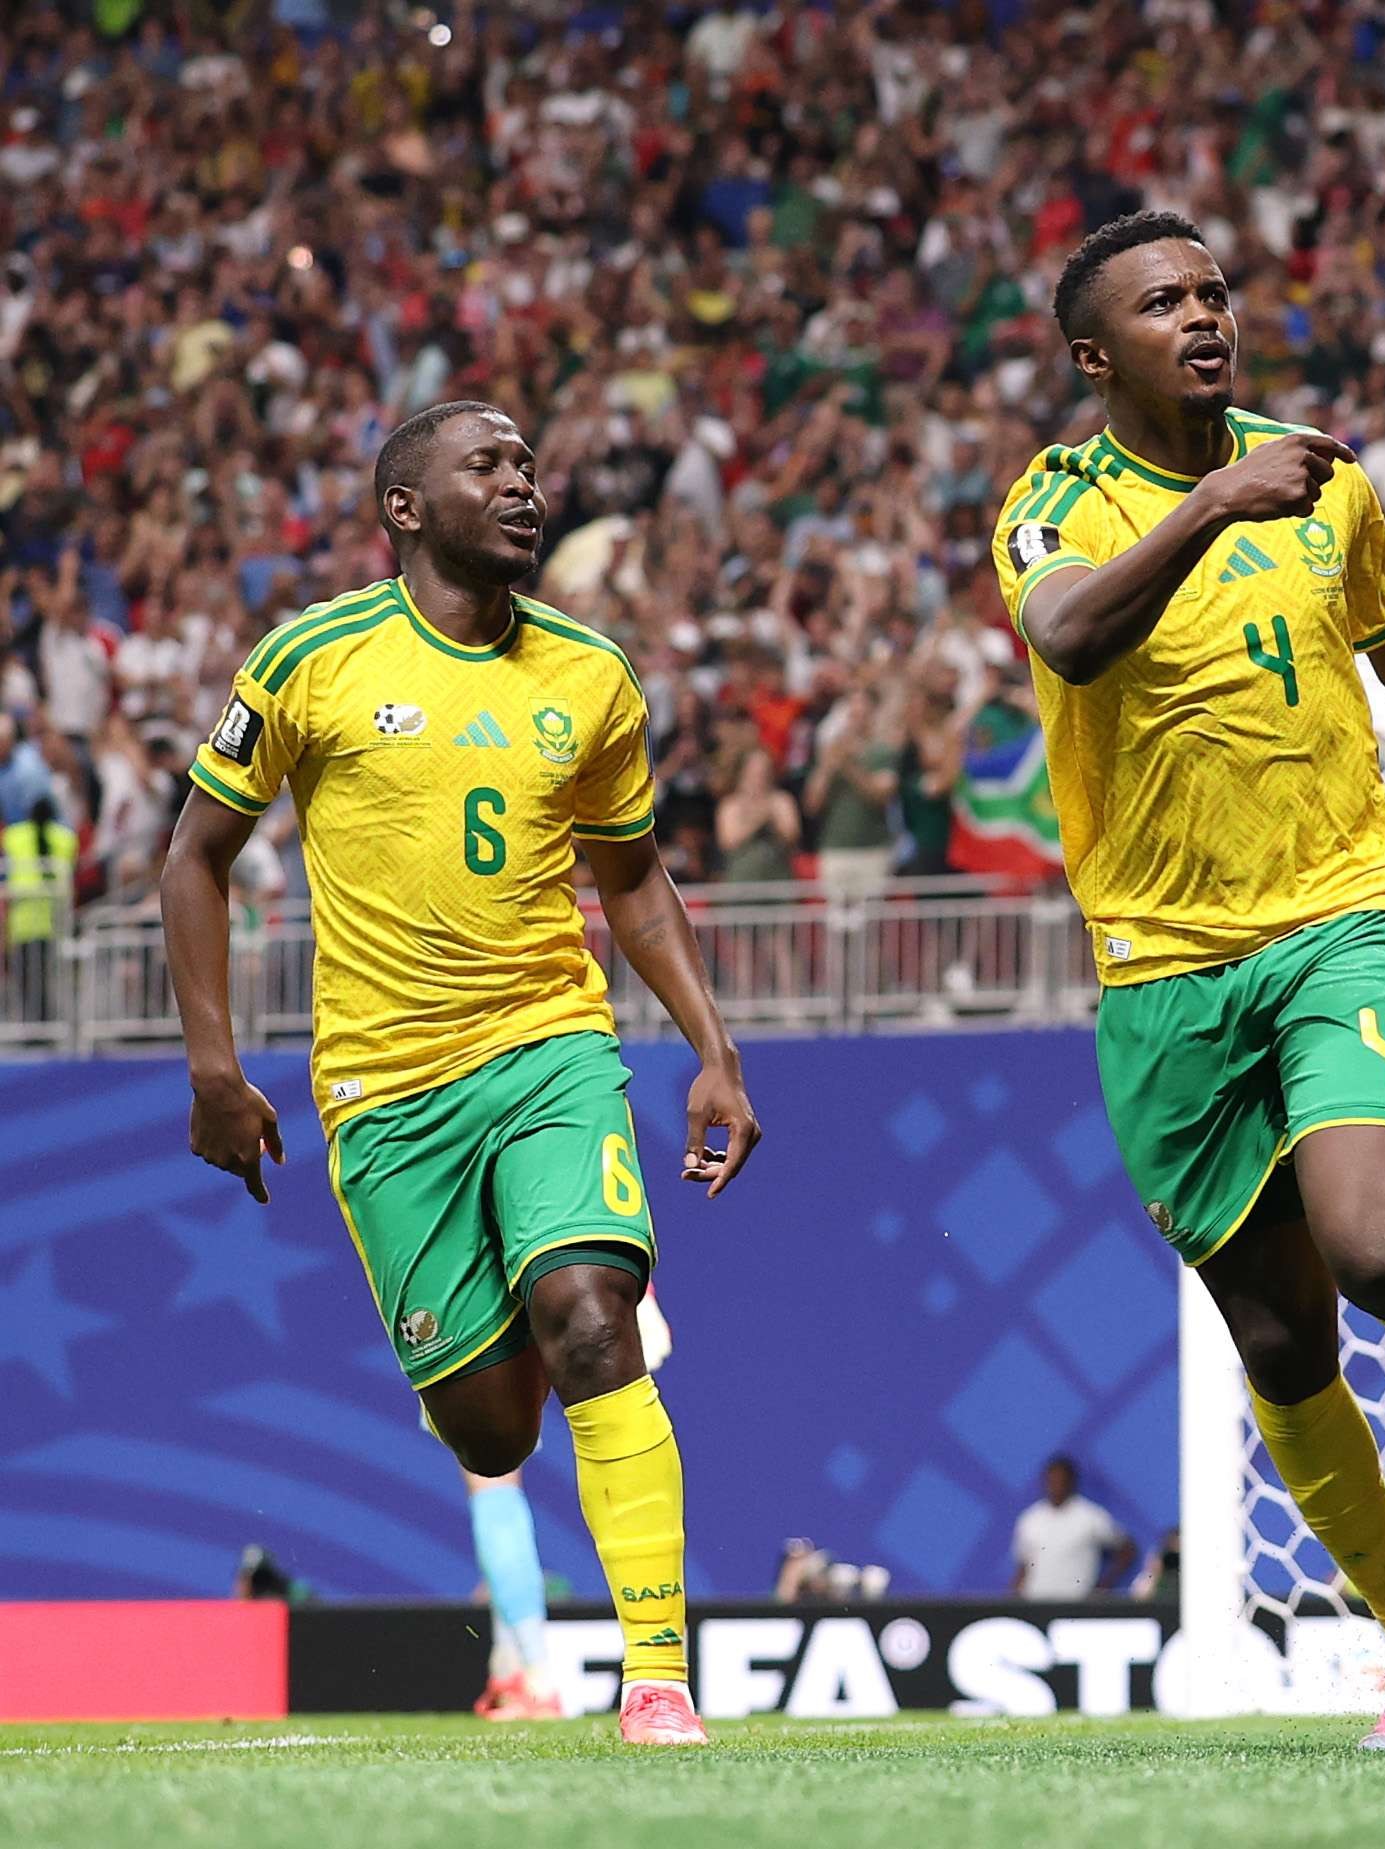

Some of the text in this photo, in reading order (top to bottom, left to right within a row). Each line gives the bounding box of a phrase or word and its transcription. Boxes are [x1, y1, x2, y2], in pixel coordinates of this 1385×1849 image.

[1243, 615, 1300, 708] 4
[464, 787, 507, 876] 6
[602, 1133, 643, 1217] 6
[622, 1582, 682, 1602] SAFA
[543, 1617, 899, 1718] FFA
